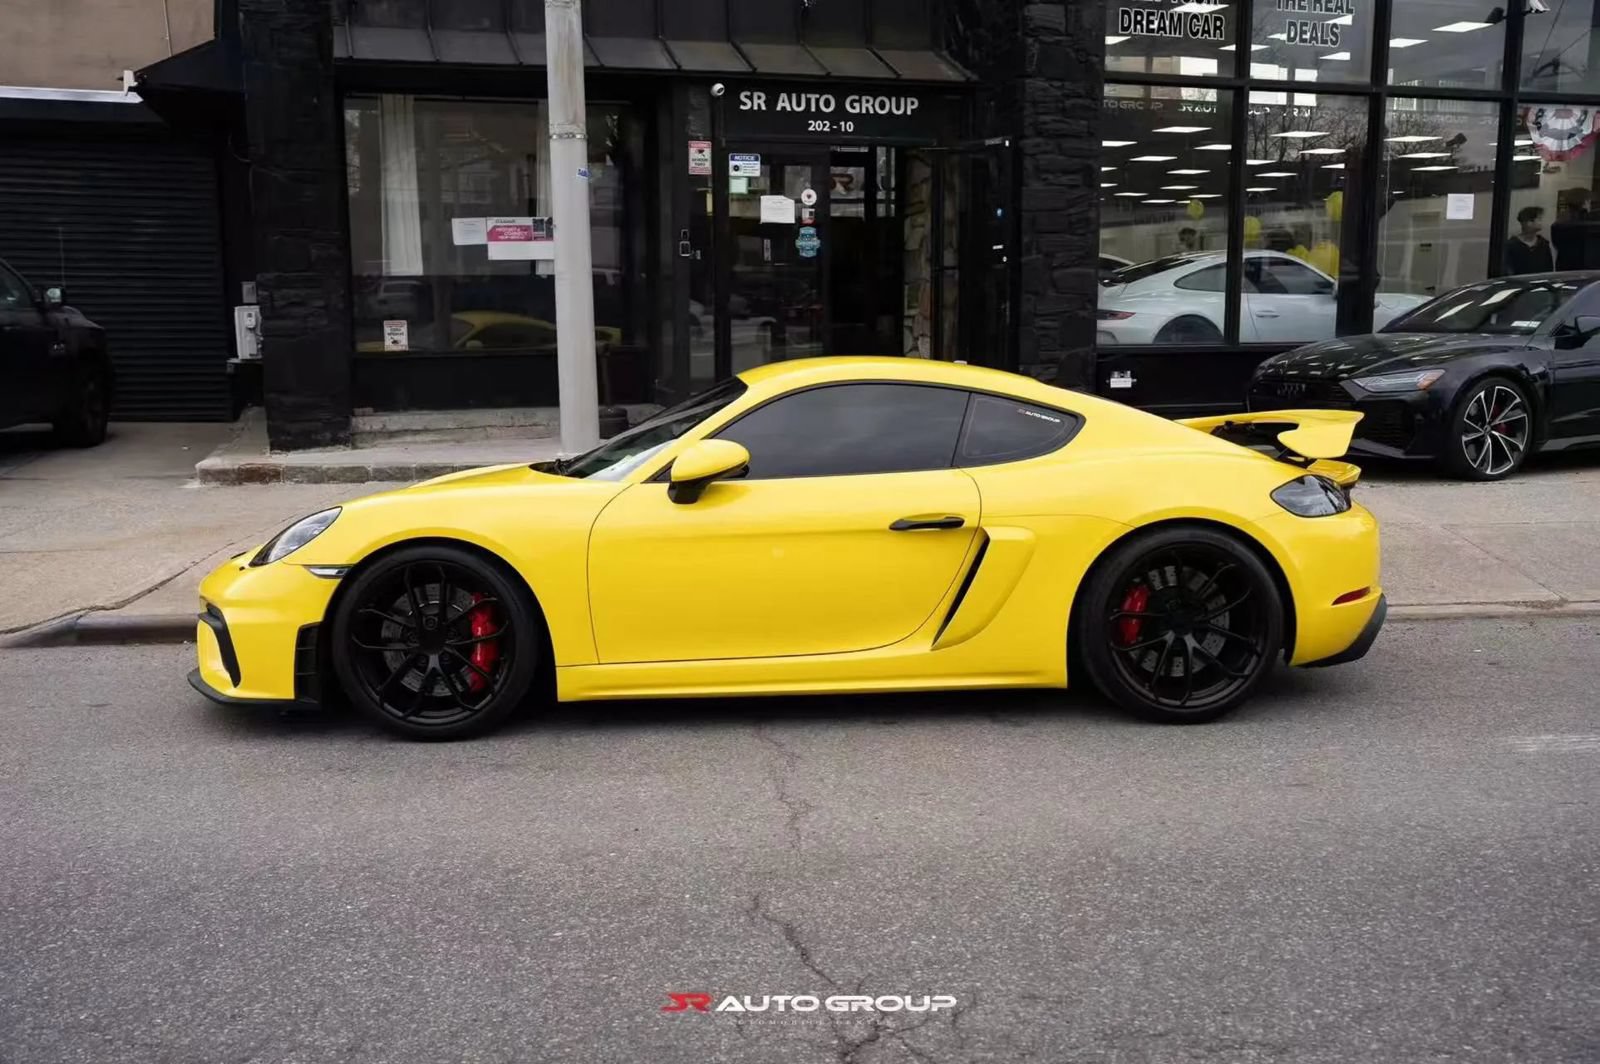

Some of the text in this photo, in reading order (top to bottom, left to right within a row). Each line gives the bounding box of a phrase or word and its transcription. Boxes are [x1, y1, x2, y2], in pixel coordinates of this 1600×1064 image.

[1119, 7, 1224, 40] DREAM CAR
[1285, 19, 1340, 48] DEALS
[739, 91, 919, 115] SR AUTO GROUP
